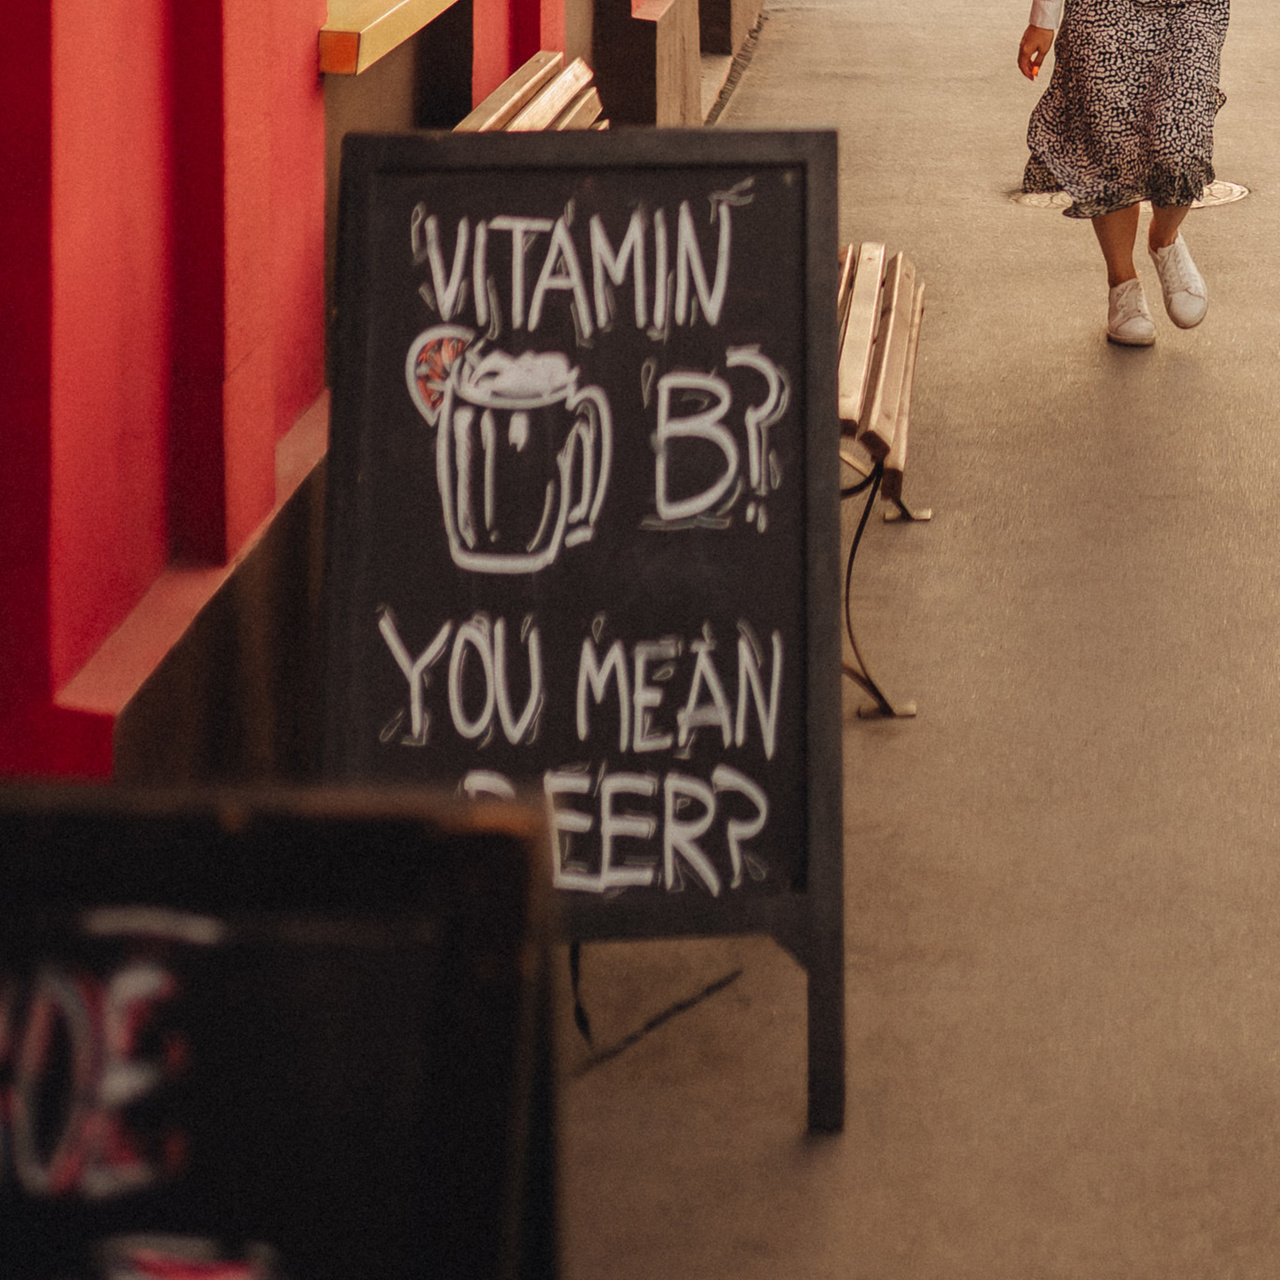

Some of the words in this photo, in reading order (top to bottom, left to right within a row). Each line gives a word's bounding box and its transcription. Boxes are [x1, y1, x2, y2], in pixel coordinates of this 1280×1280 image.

[416, 192, 738, 342] VITAMIN
[654, 348, 787, 526] B?
[378, 608, 542, 745] YOU
[575, 630, 782, 759] MEAN
[461, 764, 768, 896] EER?
